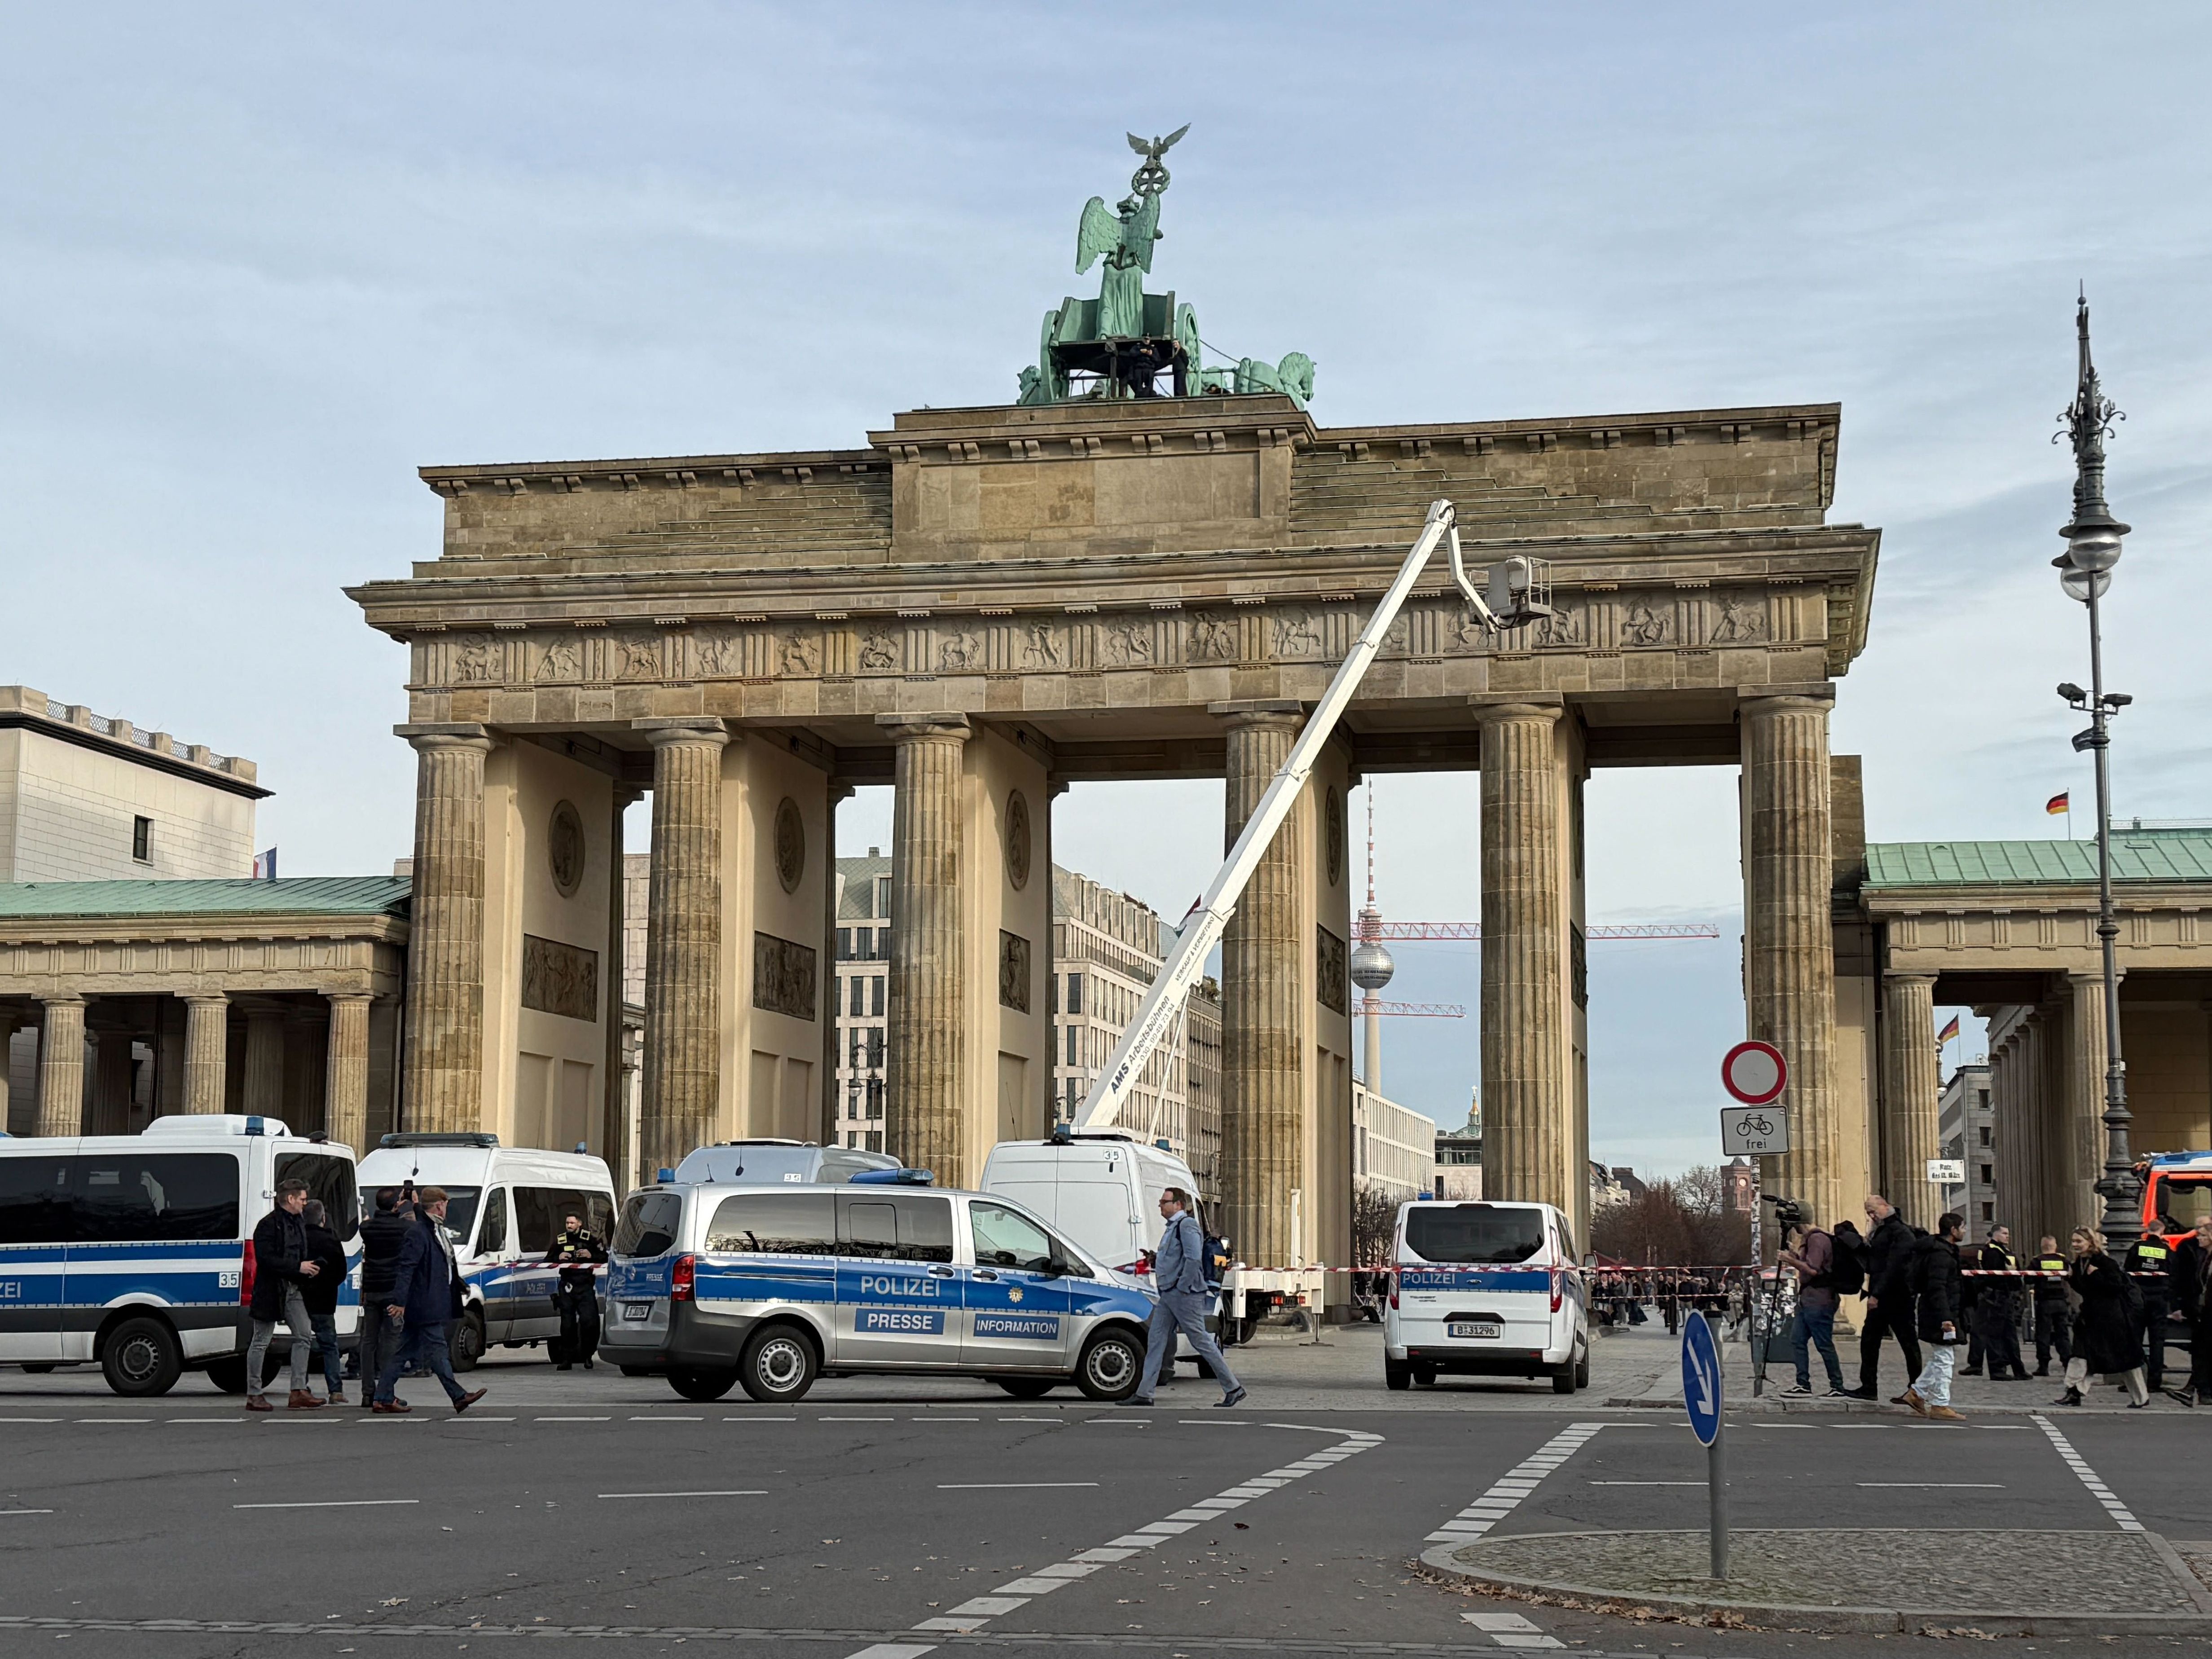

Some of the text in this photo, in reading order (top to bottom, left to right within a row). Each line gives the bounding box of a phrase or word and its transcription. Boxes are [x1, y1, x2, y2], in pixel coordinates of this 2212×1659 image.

[1111, 995, 1170, 1094] AMS Arbeitsbühnen
[1746, 1138, 1767, 1149] frei
[1104, 1151, 1119, 1160] 35
[221, 1274, 237, 1286] 35
[1403, 1273, 1455, 1284] POLIZEI
[861, 1276, 940, 1297] POLIZEI
[867, 1313, 933, 1329] PRESSE
[976, 1320, 1056, 1334] INFORMATION
